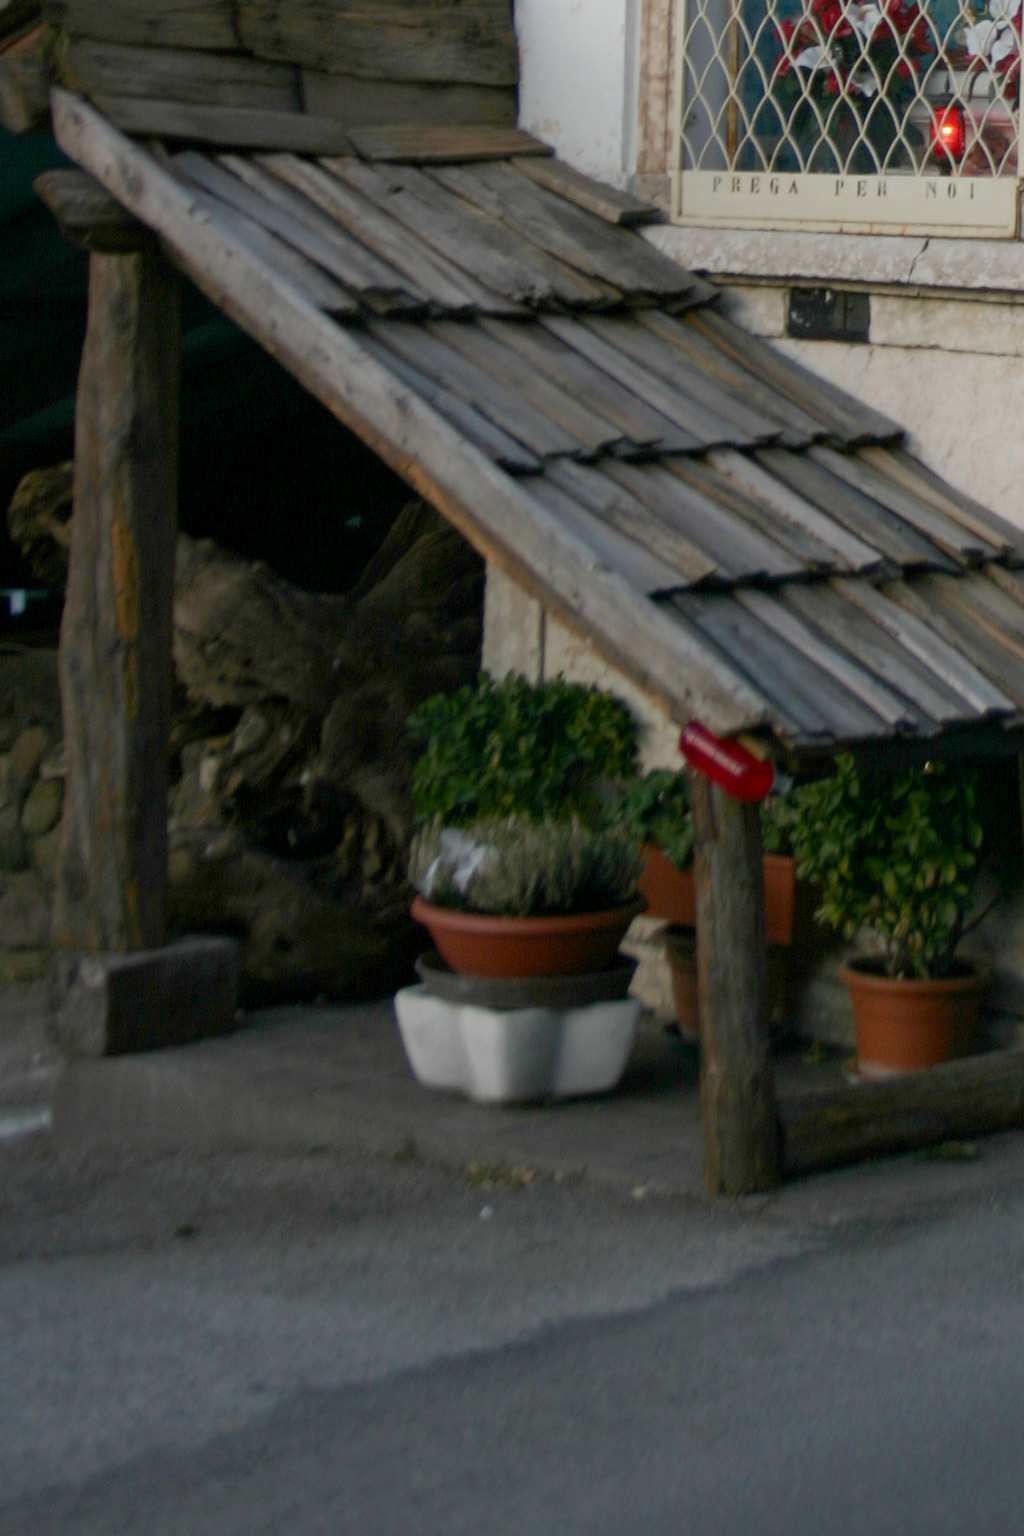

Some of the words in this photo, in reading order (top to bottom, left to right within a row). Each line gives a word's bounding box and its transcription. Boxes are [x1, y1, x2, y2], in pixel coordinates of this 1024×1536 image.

[711, 175, 799, 195] PREGA
[834, 181, 888, 198] PER
[925, 182, 975, 200] NOI
